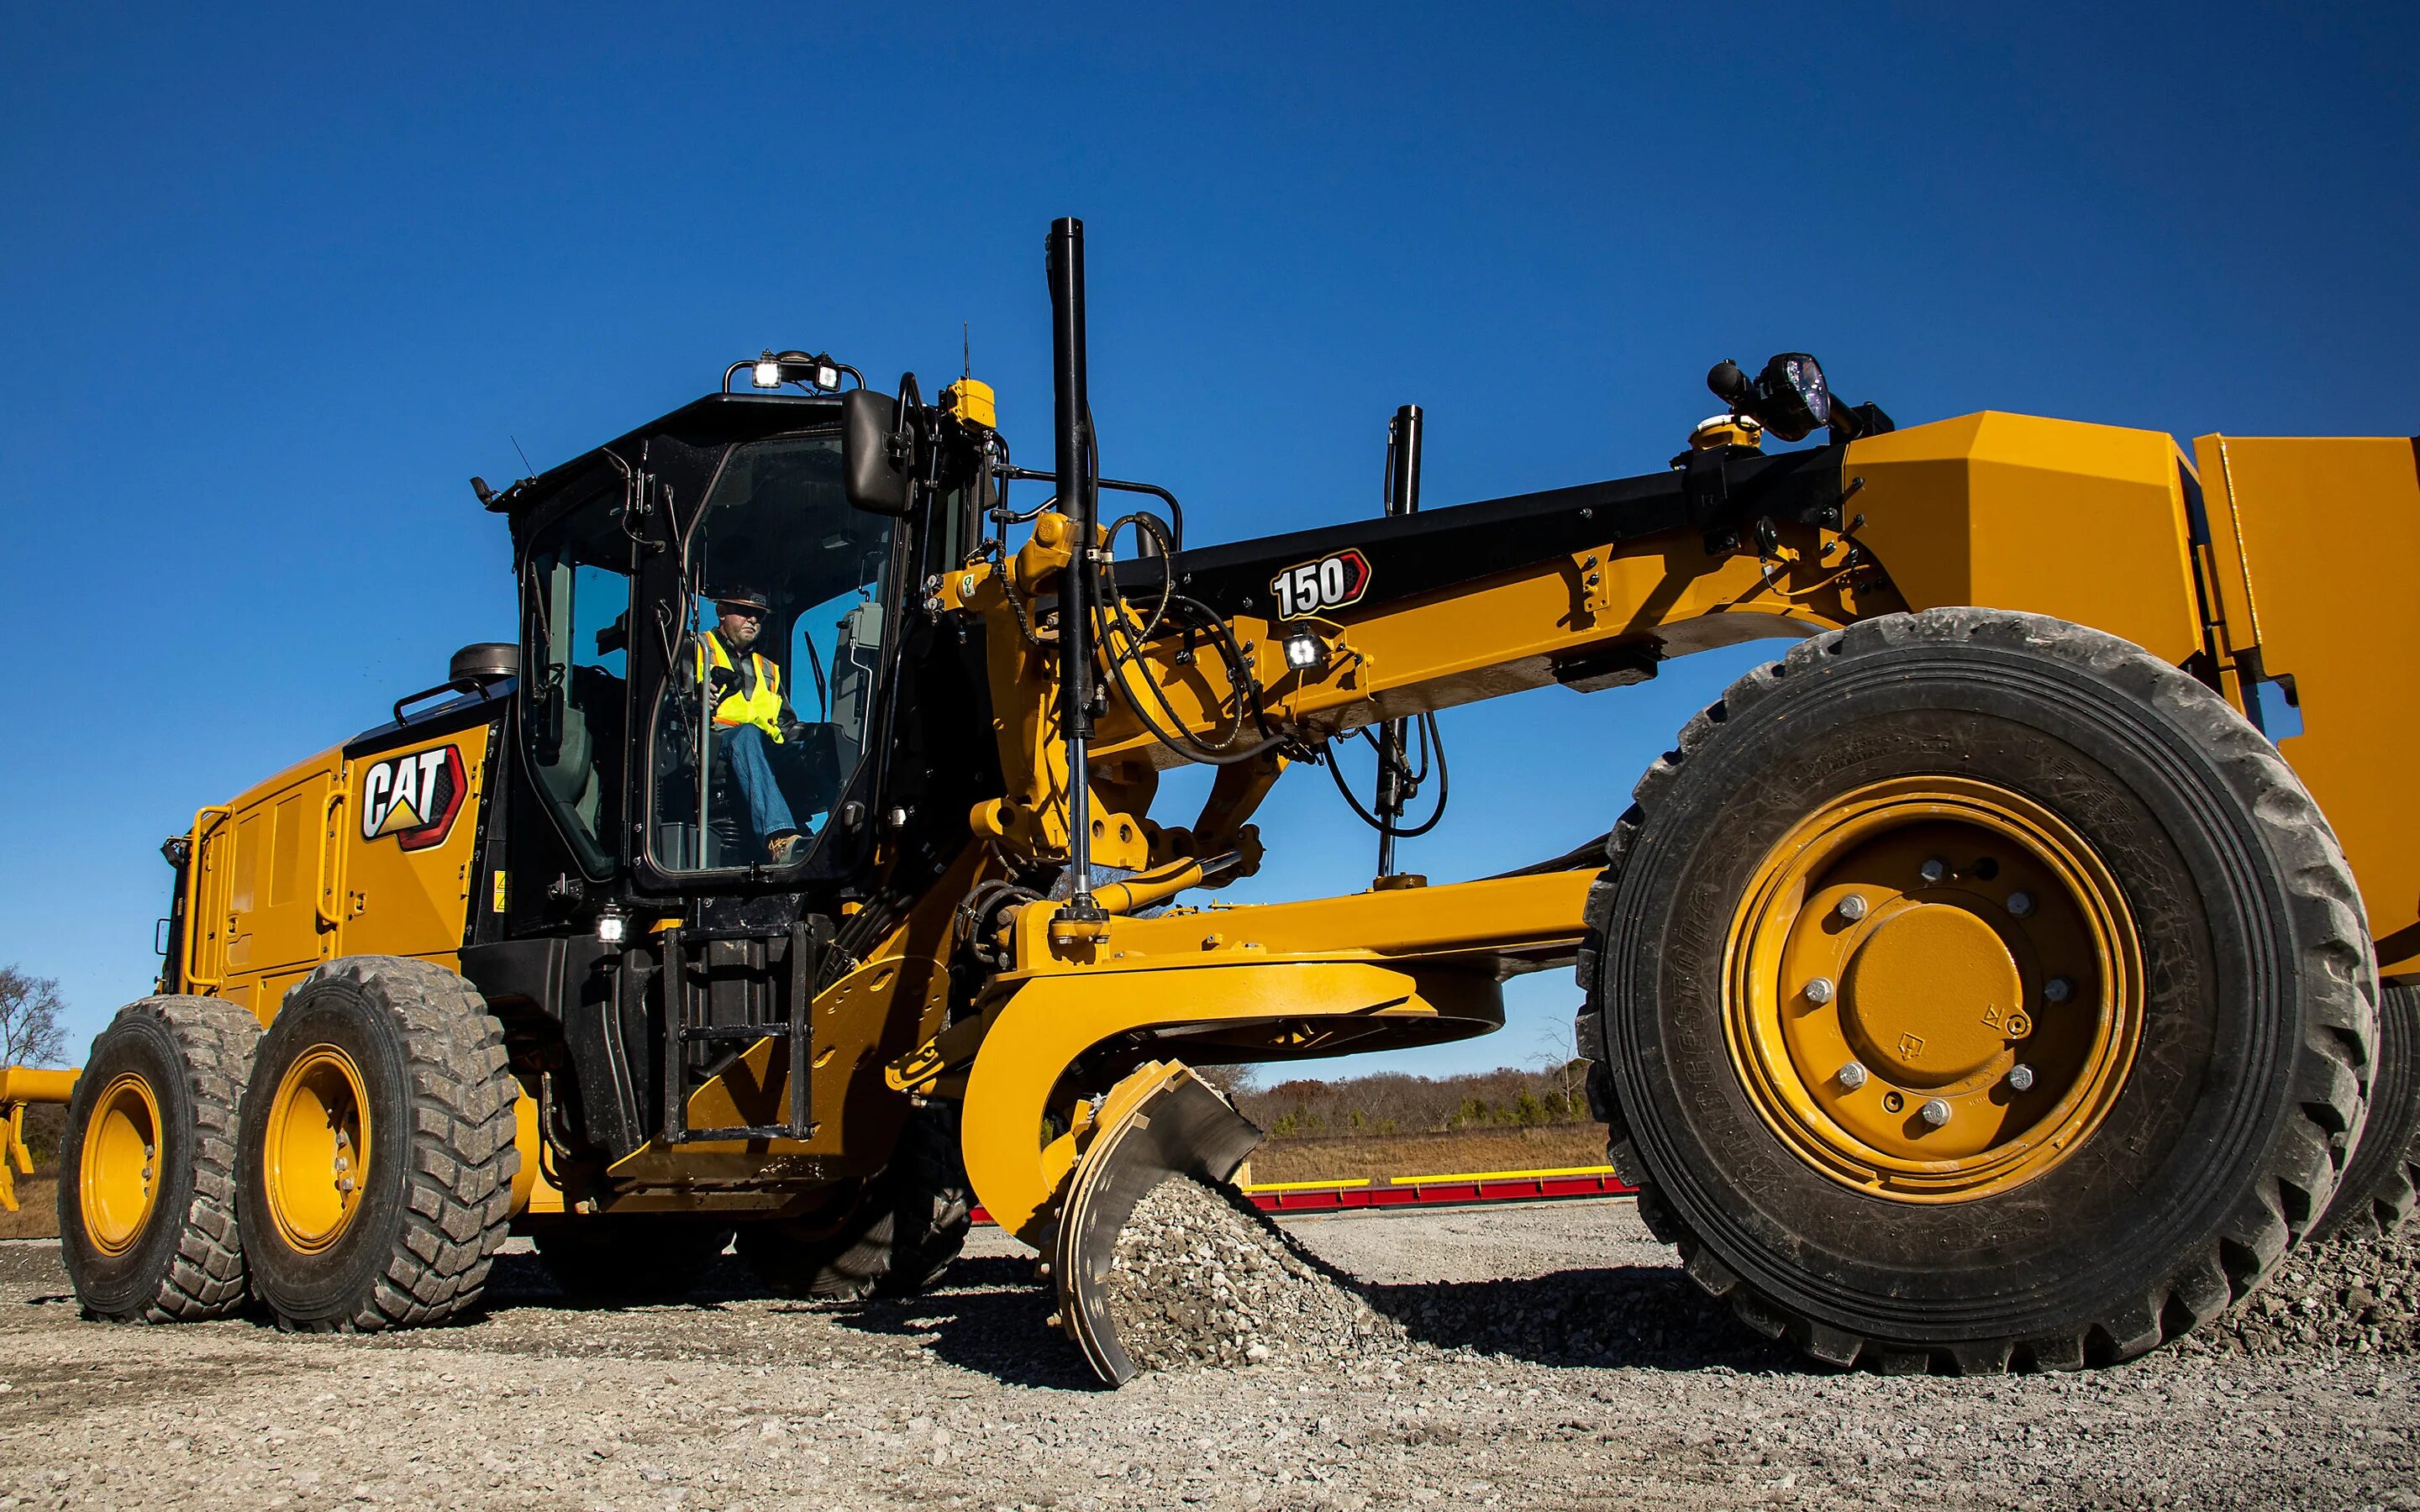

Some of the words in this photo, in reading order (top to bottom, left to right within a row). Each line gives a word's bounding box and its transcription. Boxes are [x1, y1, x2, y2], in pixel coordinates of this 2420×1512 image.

[1274, 559, 1344, 615] 150
[363, 748, 446, 837] CAT
[1829, 746, 1891, 771] RESISTANT
[1672, 886, 1791, 1194] BRIDGESTONE
